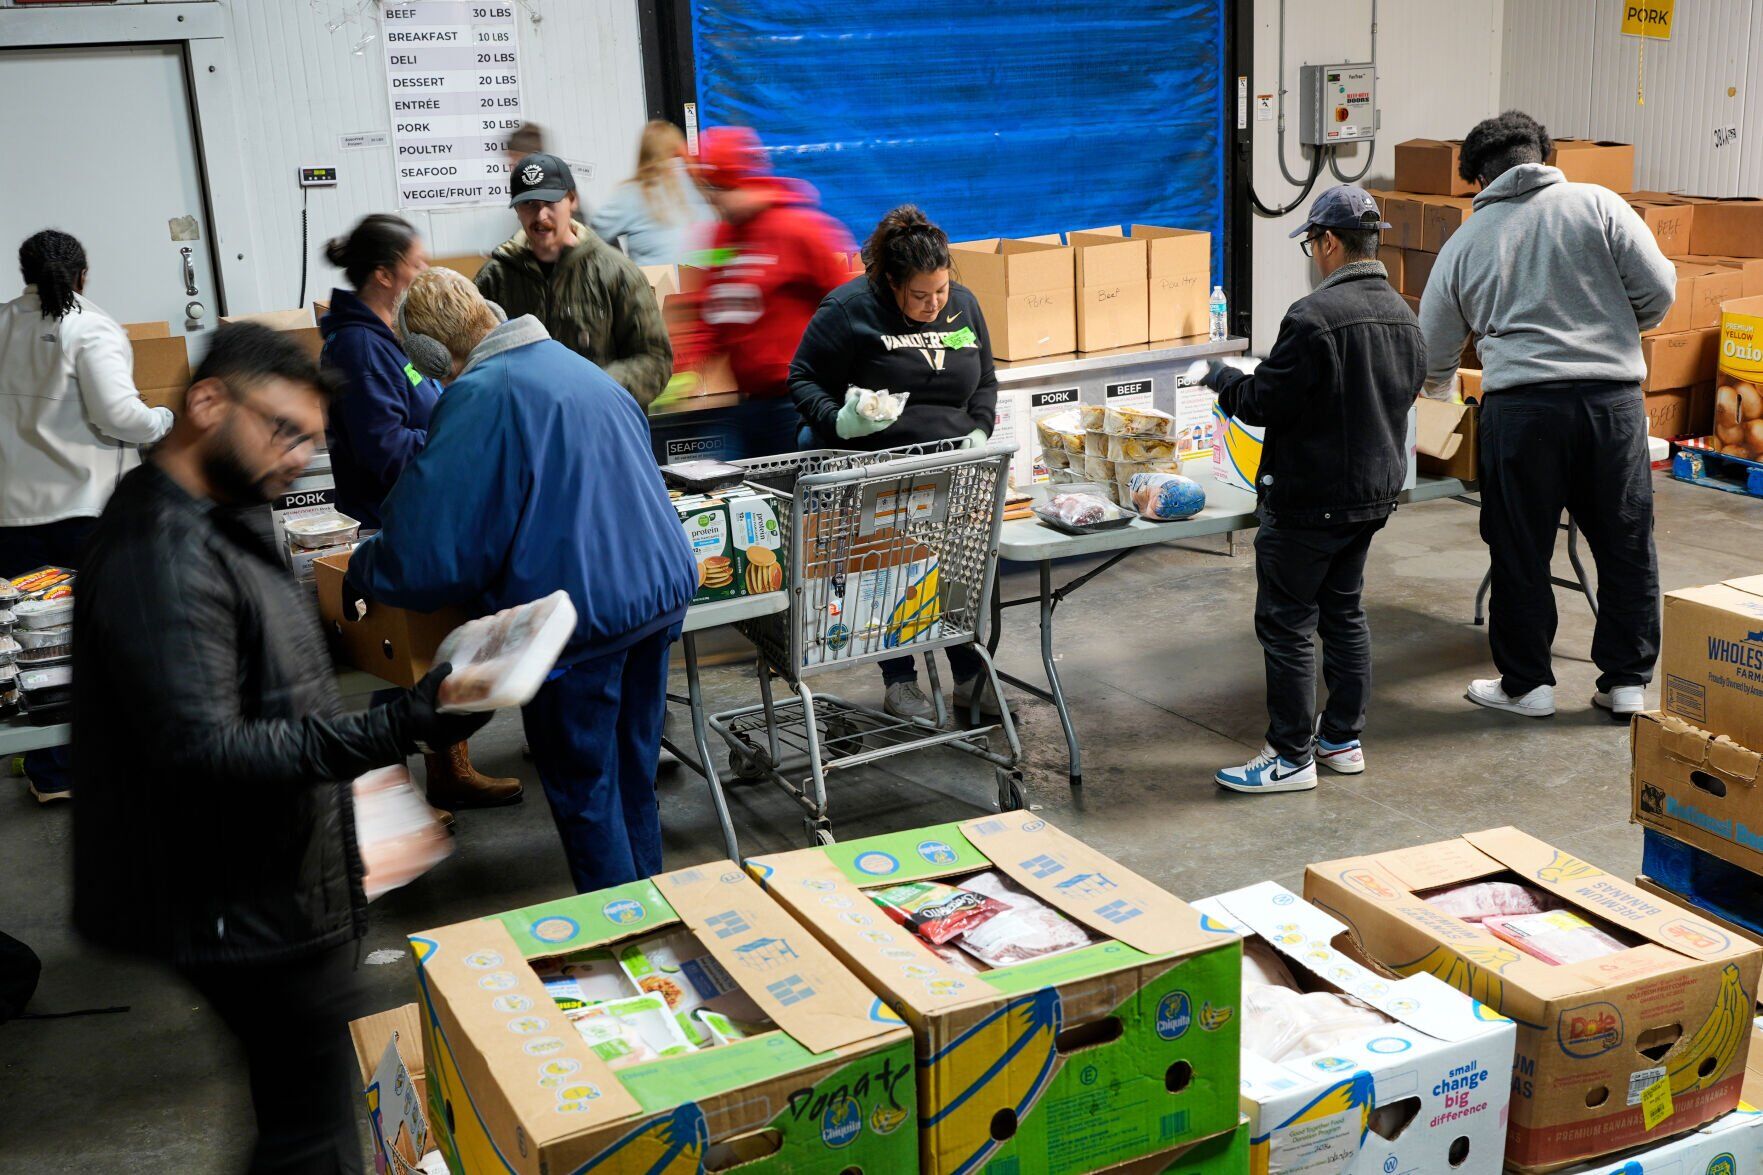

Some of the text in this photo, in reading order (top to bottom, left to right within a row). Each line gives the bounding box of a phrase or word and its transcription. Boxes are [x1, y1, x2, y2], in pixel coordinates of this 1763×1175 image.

[386, 10, 417, 19] BEEF
[473, 8, 512, 18] 30 LBS
[1627, 6, 1669, 25] PORK
[388, 32, 458, 42] BREAKFAST
[479, 33, 509, 41] 10 LBS
[390, 55, 417, 65] DELI
[477, 53, 515, 63] 20 LBS
[392, 77, 445, 88] DESSERT
[479, 75, 517, 85] 20 LBS
[395, 98, 441, 111] ENTRÉE
[481, 97, 519, 108] 20 LBS
[397, 123, 431, 133] PORK
[482, 120, 520, 130] 30 LBS
[399, 145, 453, 155] POULTRY
[484, 143, 498, 152] 30
[401, 166, 457, 178] SEAFOOD
[486, 164, 500, 174] 20
[403, 186, 482, 200] VEGGIE/FRUIT
[488, 186, 501, 195] 20
[1726, 322, 1755, 332] PREMIUM
[1725, 331, 1754, 341] YELLOW
[1117, 383, 1142, 395] BEEF
[1041, 391, 1070, 404] PORK
[670, 440, 722, 453] SEAFOOD
[285, 492, 326, 507] PORK
[691, 526, 719, 538] protein
[756, 513, 765, 540] protein
[1726, 677, 1743, 691] Owned
[1743, 682, 1751, 694] by
[1576, 886, 1647, 921] PREMIUM
[1592, 880, 1662, 916] BANANAS
[1156, 1016, 1190, 1032] Chiquita
[1570, 1011, 1616, 1040] Dole
[1449, 1060, 1477, 1078] small
[1432, 1069, 1489, 1097] change
[1445, 1091, 1470, 1109] big
[1694, 1086, 1729, 1107] BANANAS
[1430, 1102, 1488, 1128] difference
[822, 1121, 861, 1141] Chiquita
[1555, 1117, 1645, 1142] PREMIUM BANANAS
